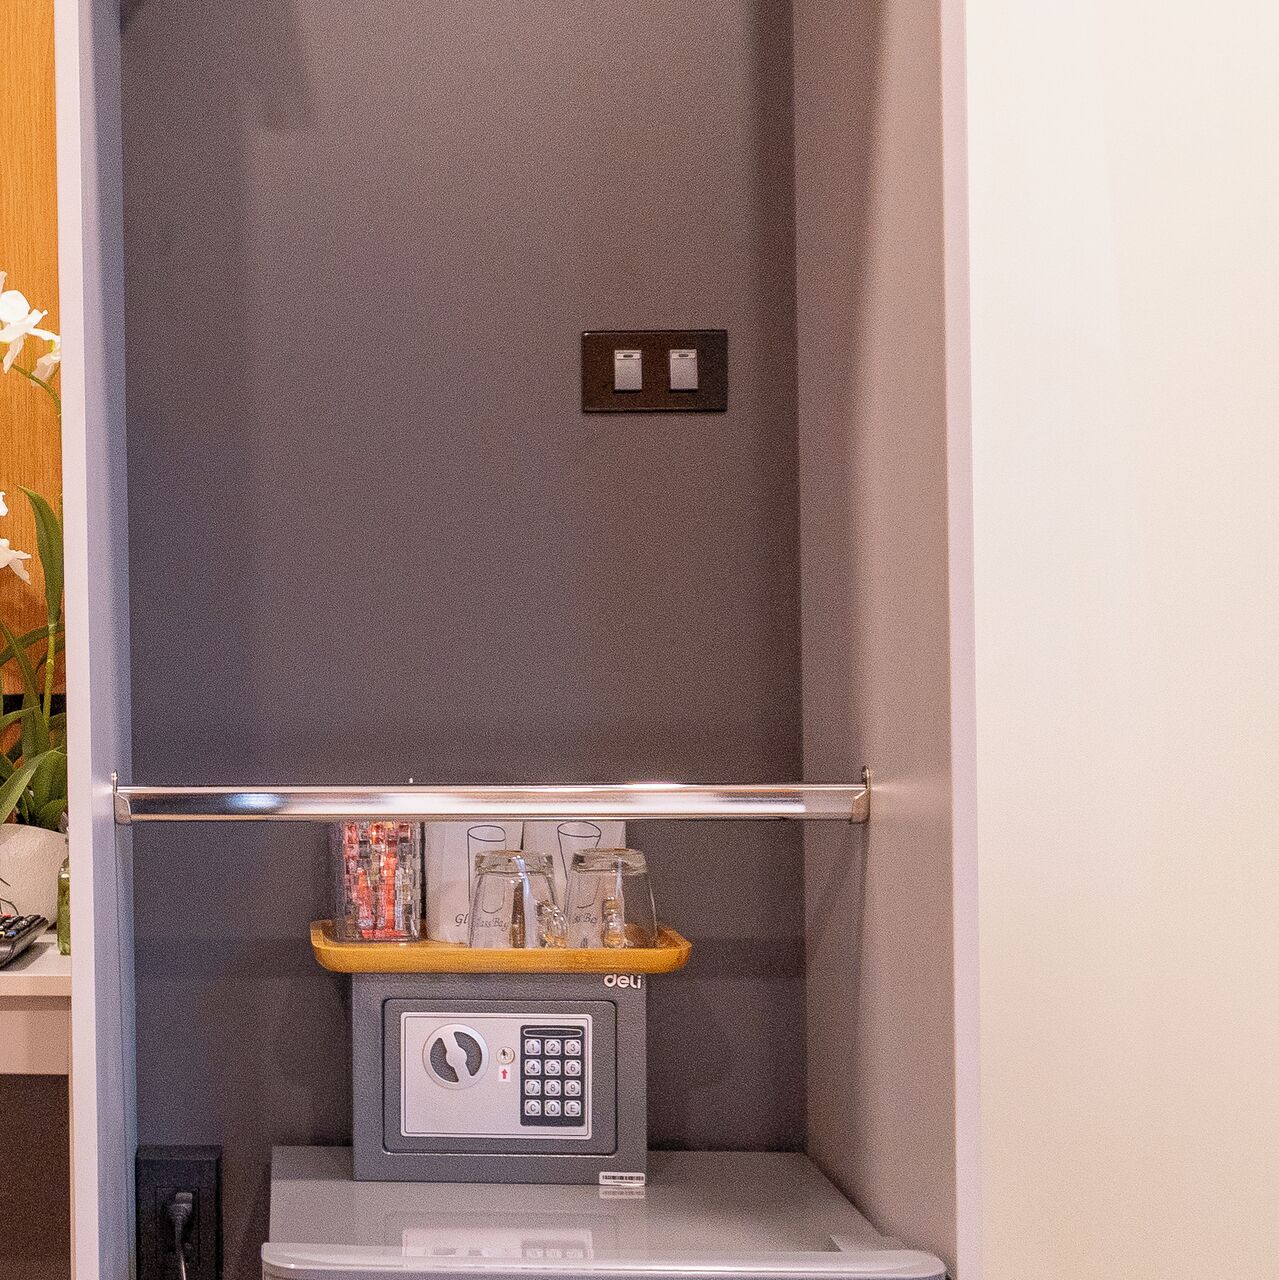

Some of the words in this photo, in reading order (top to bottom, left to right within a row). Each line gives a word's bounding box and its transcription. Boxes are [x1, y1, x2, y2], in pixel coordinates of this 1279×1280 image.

[603, 974, 642, 989] deli
[549, 1043, 556, 1052] 2
[570, 1043, 576, 1052] 3
[530, 1063, 536, 1071] 4
[549, 1063, 556, 1072] 5
[570, 1063, 576, 1072] 6
[530, 1083, 536, 1092] 7
[549, 1083, 556, 1092] 8
[570, 1083, 576, 1092] 9
[529, 1103, 536, 1112] C
[570, 1104, 576, 1113] E
